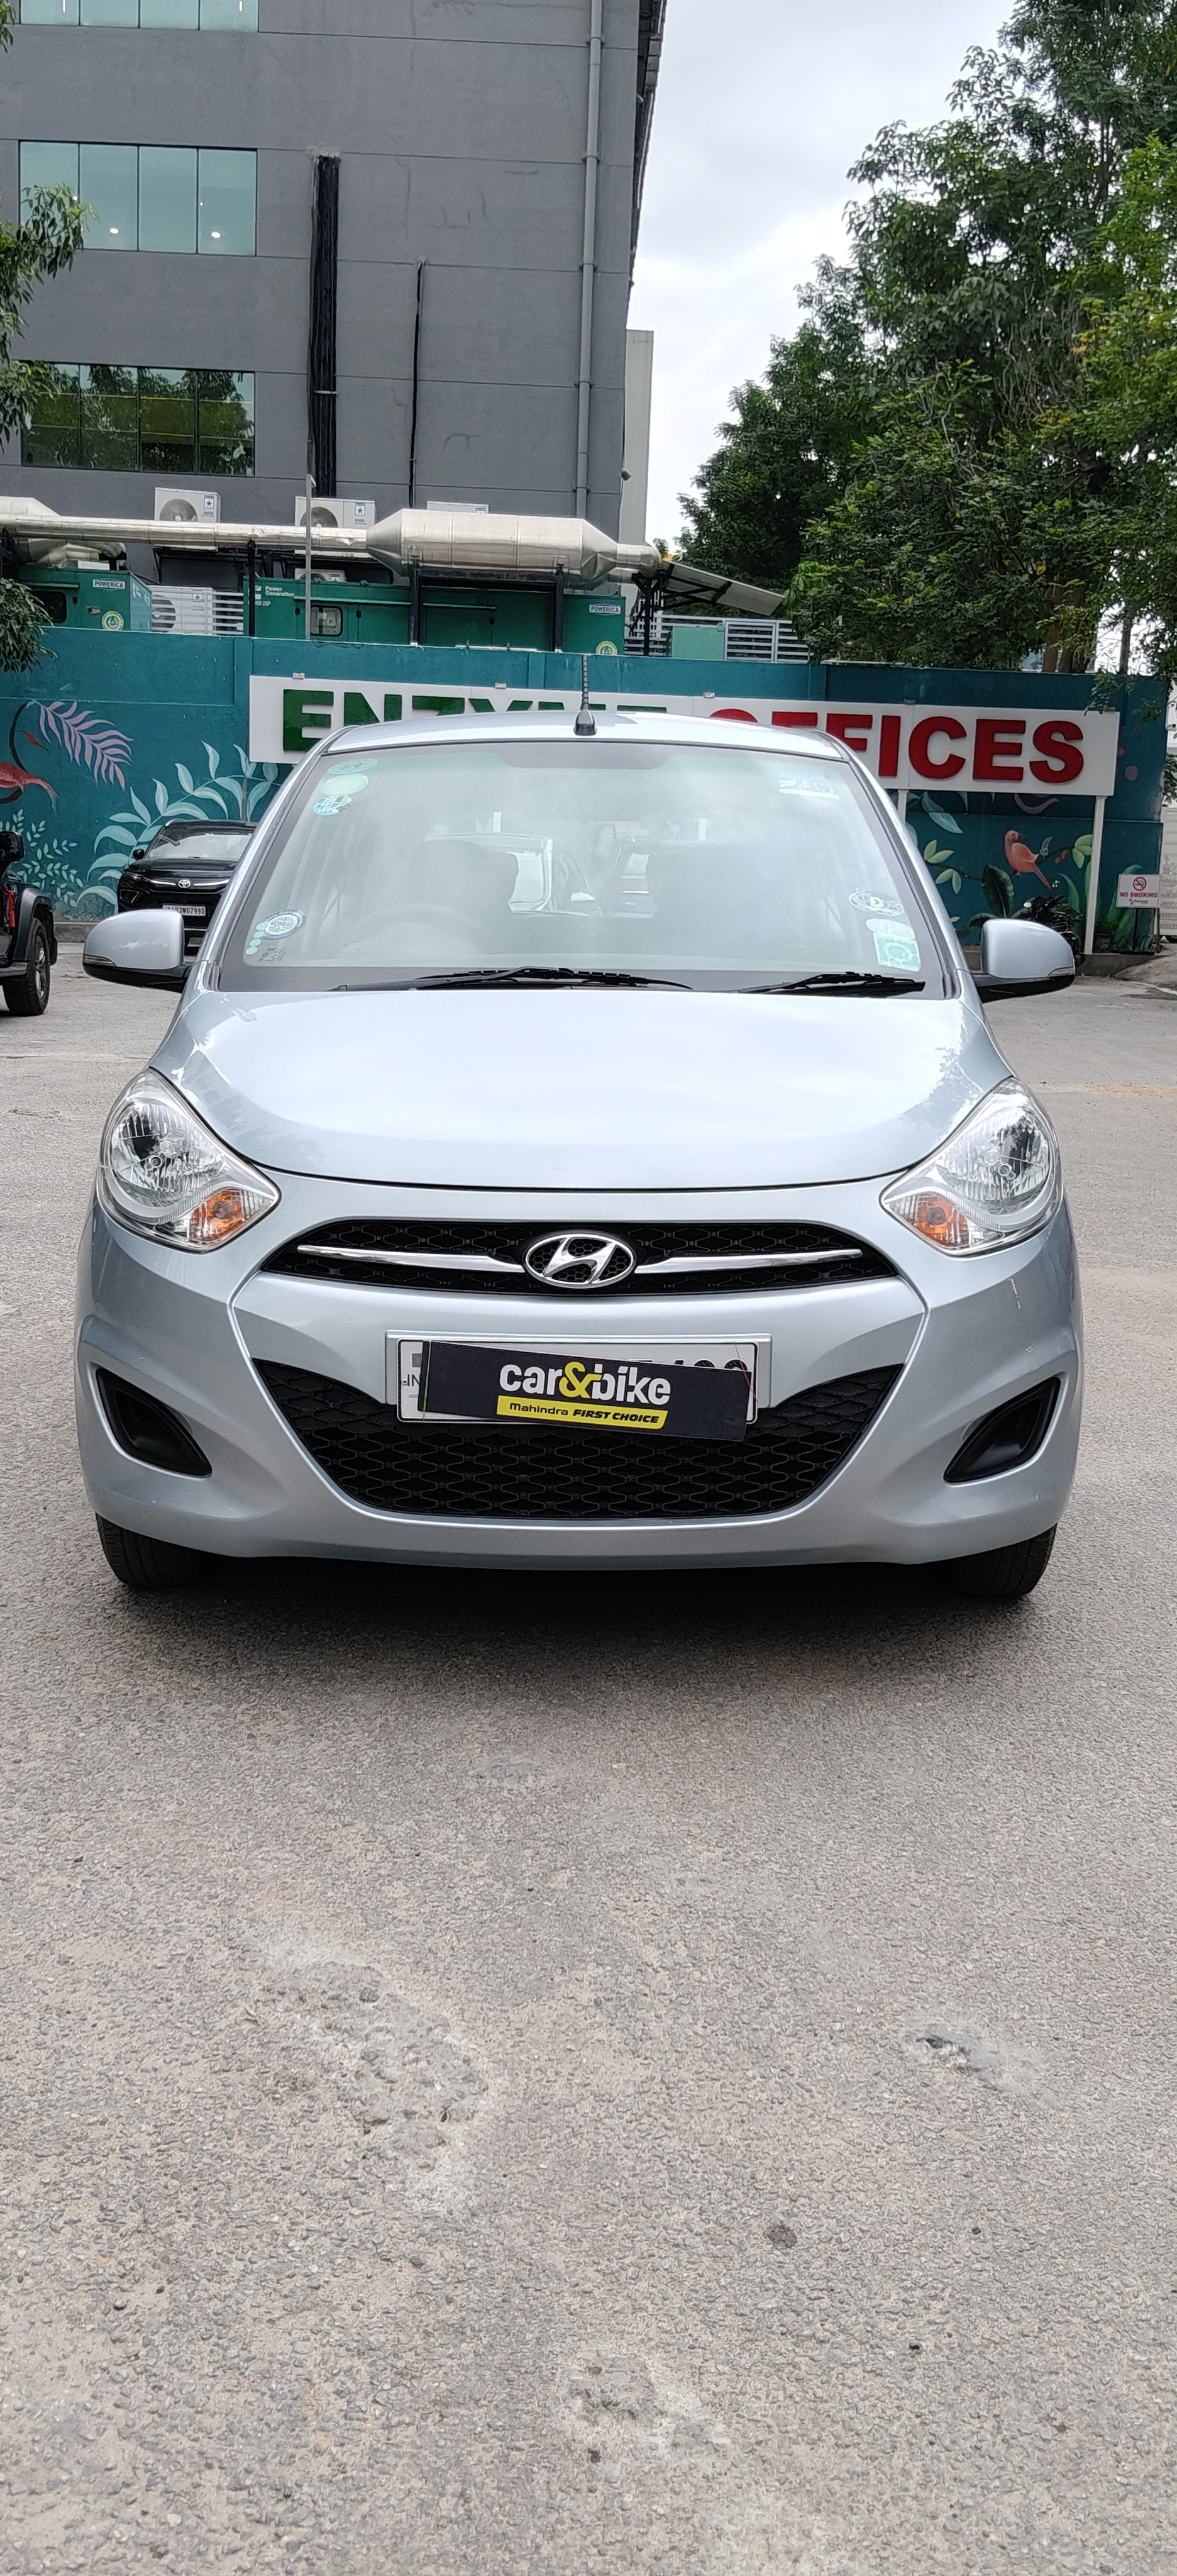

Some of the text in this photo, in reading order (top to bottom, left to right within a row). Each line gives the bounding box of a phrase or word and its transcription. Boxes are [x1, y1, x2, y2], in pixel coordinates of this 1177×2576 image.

[709, 708, 1084, 784] FICES
[499, 1361, 671, 1405] car&bike
[573, 1409, 612, 1419] FIRST
[612, 1412, 660, 1423] CHOICE
